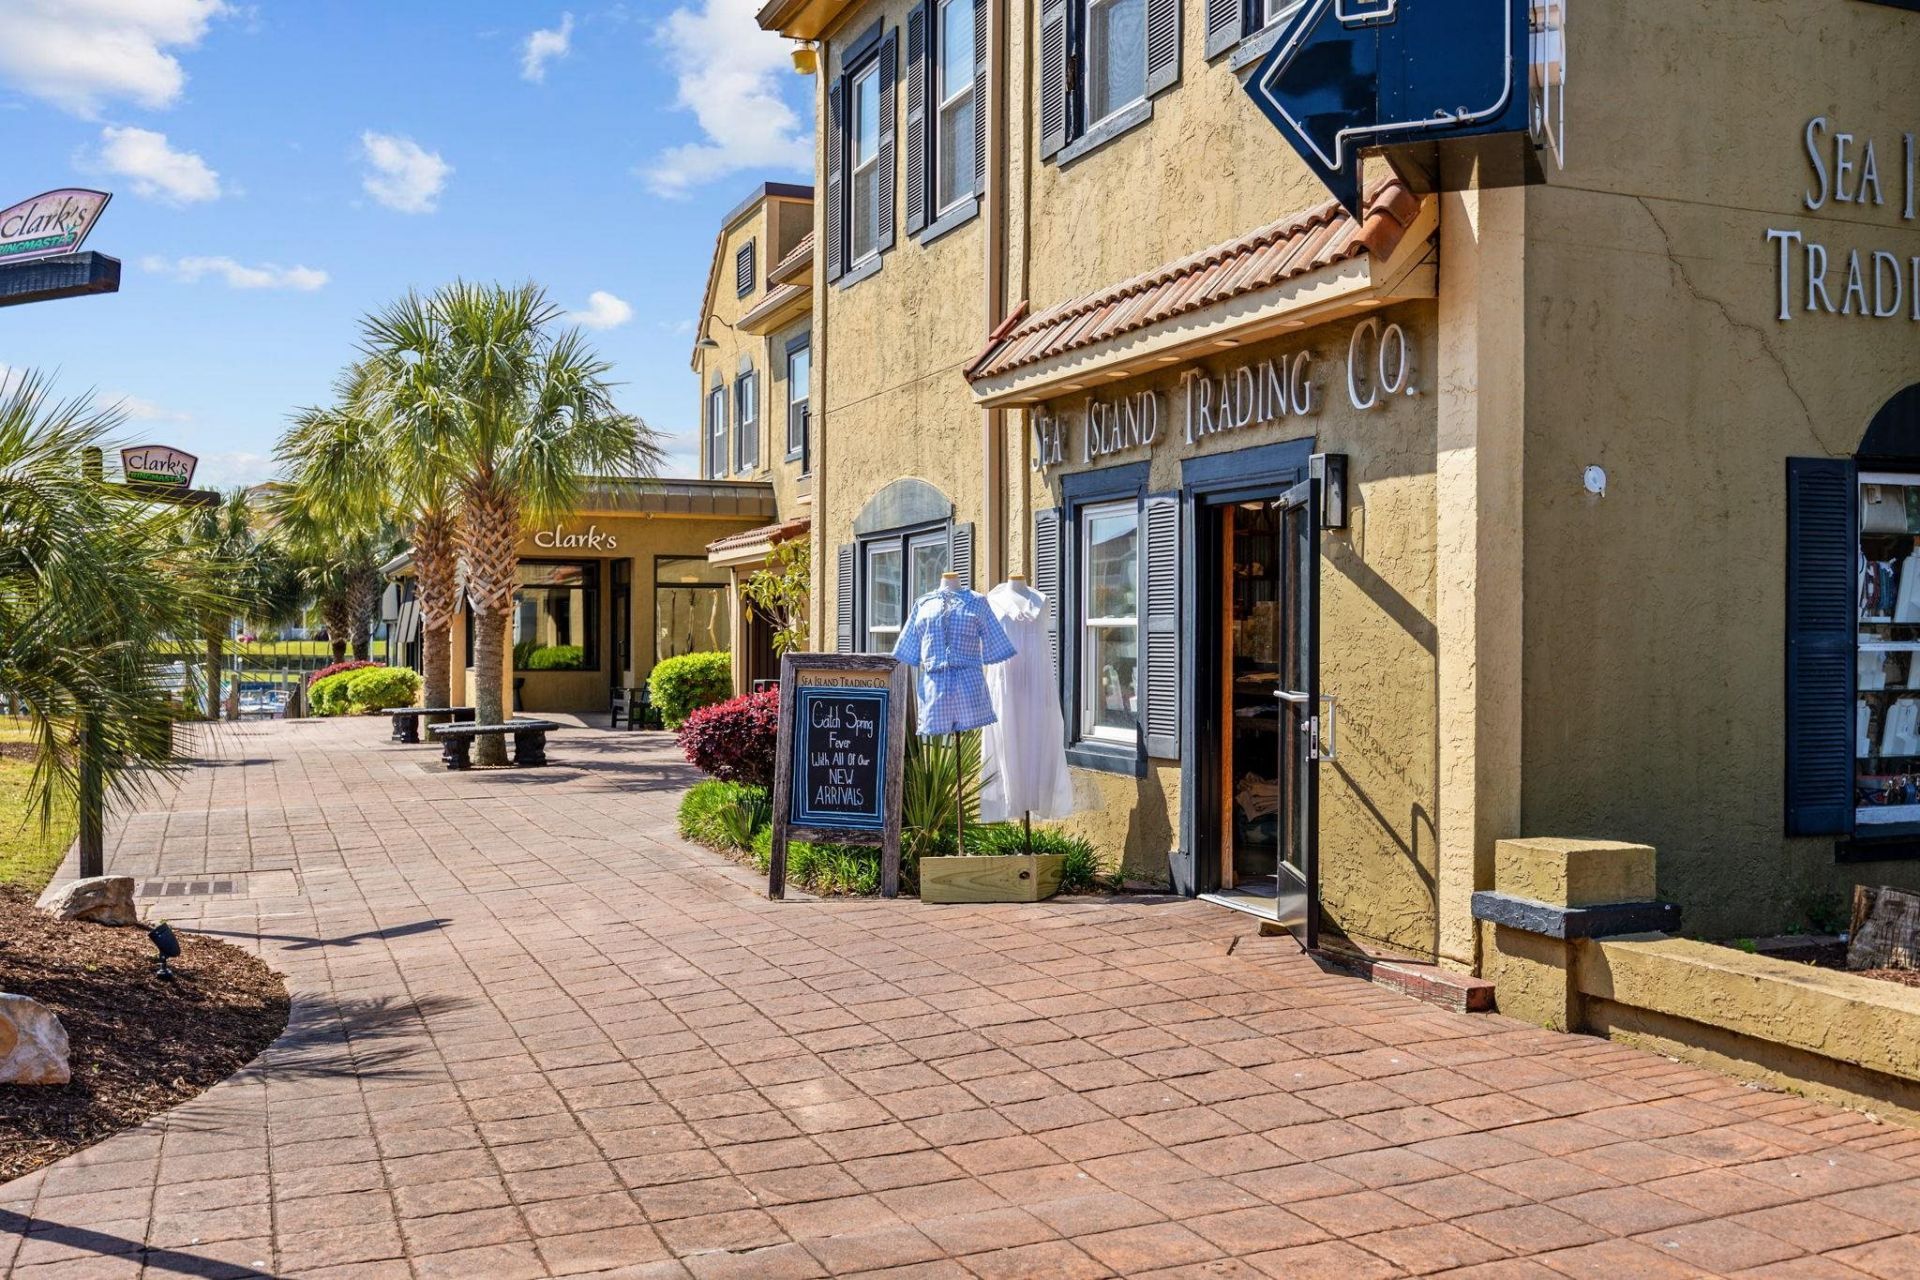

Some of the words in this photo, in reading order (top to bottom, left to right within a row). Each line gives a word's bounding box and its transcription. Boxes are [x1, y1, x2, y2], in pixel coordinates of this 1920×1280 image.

[1804, 116, 1885, 211] SEA
[1, 196, 88, 239] Clark's
[1032, 405, 1063, 473] SEA
[1083, 390, 1159, 464] ISLAND
[1180, 350, 1311, 446] TRADING
[1347, 316, 1418, 411] CO.
[128, 450, 188, 475] Clark's
[534, 523, 617, 551] Clark's
[801, 675, 813, 687] SEA
[814, 676, 838, 687] ISLAND
[840, 677, 872, 688] TRADING
[812, 700, 841, 729] Catch
[845, 703, 874, 739] Spring
[829, 731, 851, 749] Fever
[811, 751, 830, 767] With
[832, 752, 844, 766] All
[829, 768, 854, 785] NEW
[814, 785, 865, 806] ARRIVALS
